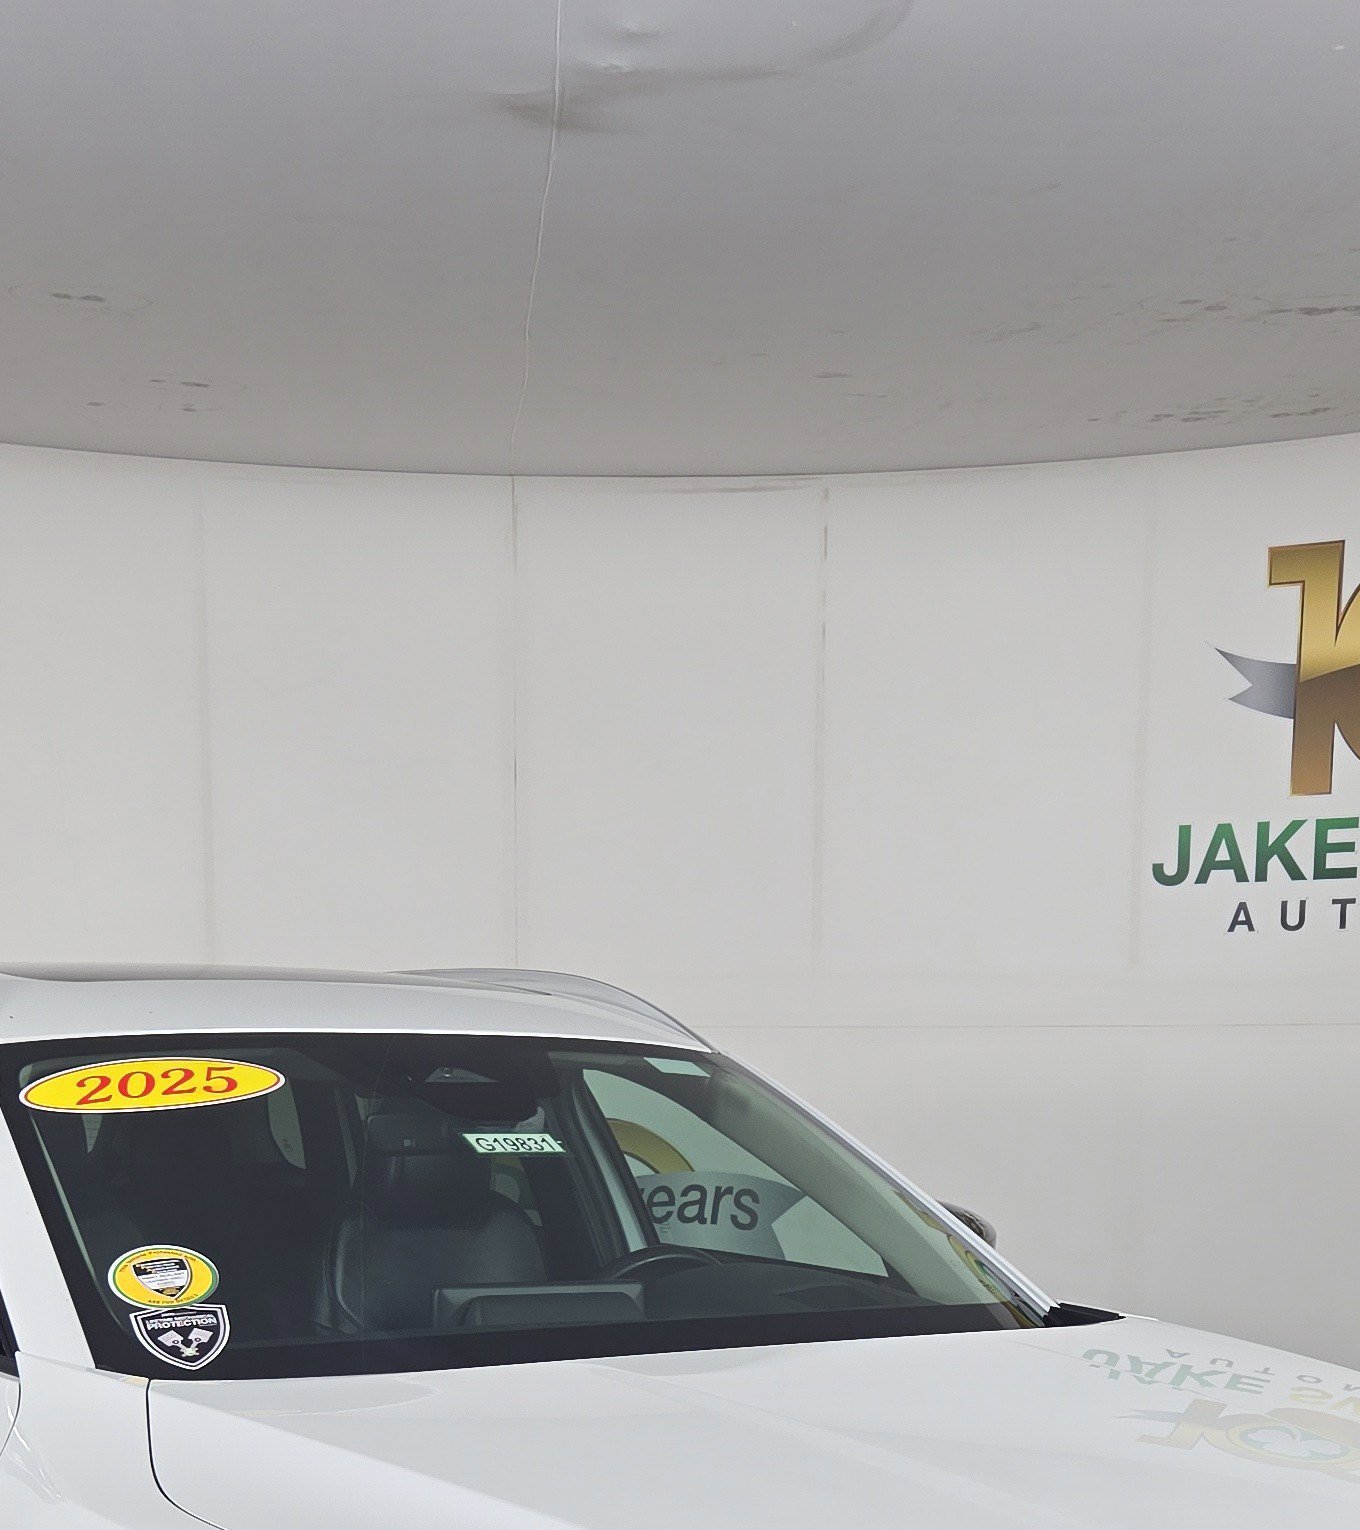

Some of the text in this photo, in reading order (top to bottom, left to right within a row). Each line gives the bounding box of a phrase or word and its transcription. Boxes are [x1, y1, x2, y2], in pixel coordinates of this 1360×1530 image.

[1152, 816, 1360, 886] JAKE
[75, 1066, 238, 1106] 2025
[475, 1137, 556, 1152] G19831
[640, 1184, 761, 1231] ears
[146, 1316, 218, 1331] PROTECTION
